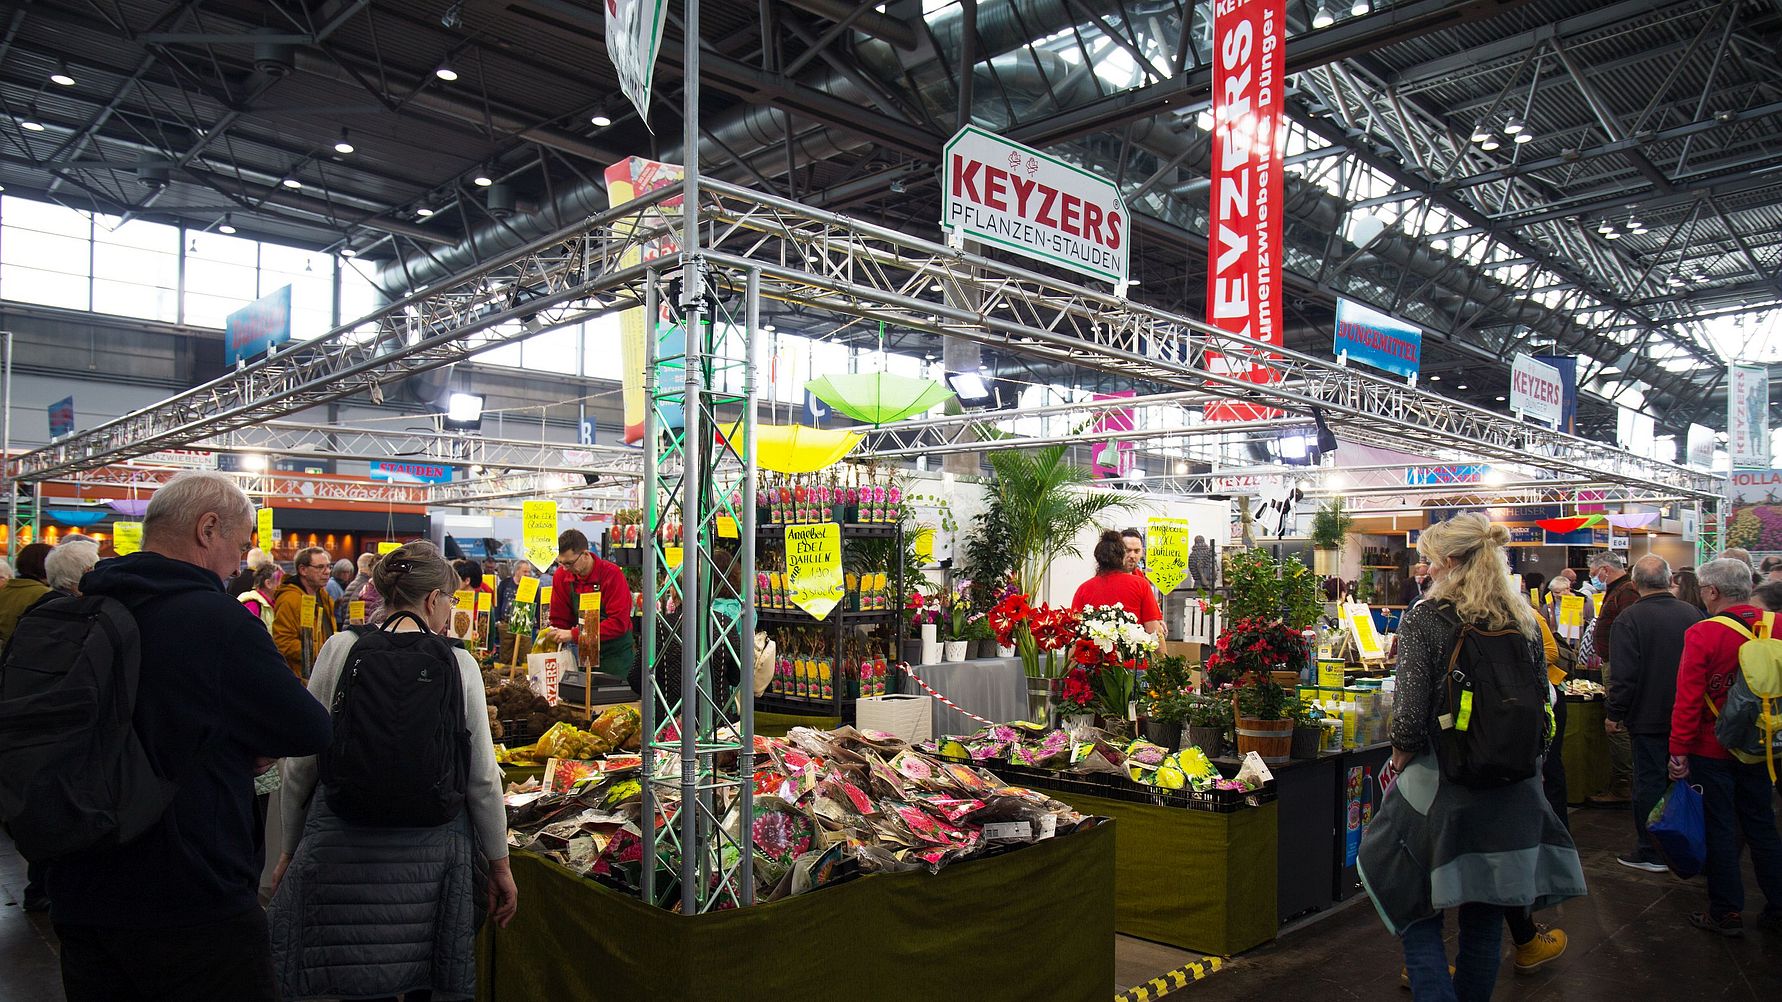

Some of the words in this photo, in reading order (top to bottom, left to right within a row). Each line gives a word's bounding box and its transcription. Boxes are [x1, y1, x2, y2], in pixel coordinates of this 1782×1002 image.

[952, 153, 1122, 250] KEYZERS
[951, 202, 1121, 272] PFLANZEN-STAUDEN
[1513, 368, 1560, 406] KEYZERS
[1737, 371, 1745, 454] KEYZERS
[379, 462, 445, 478] STAUDEN
[788, 527, 826, 545] Angebot
[1158, 535, 1176, 546] XXL
[546, 661, 557, 707] EYZERS
